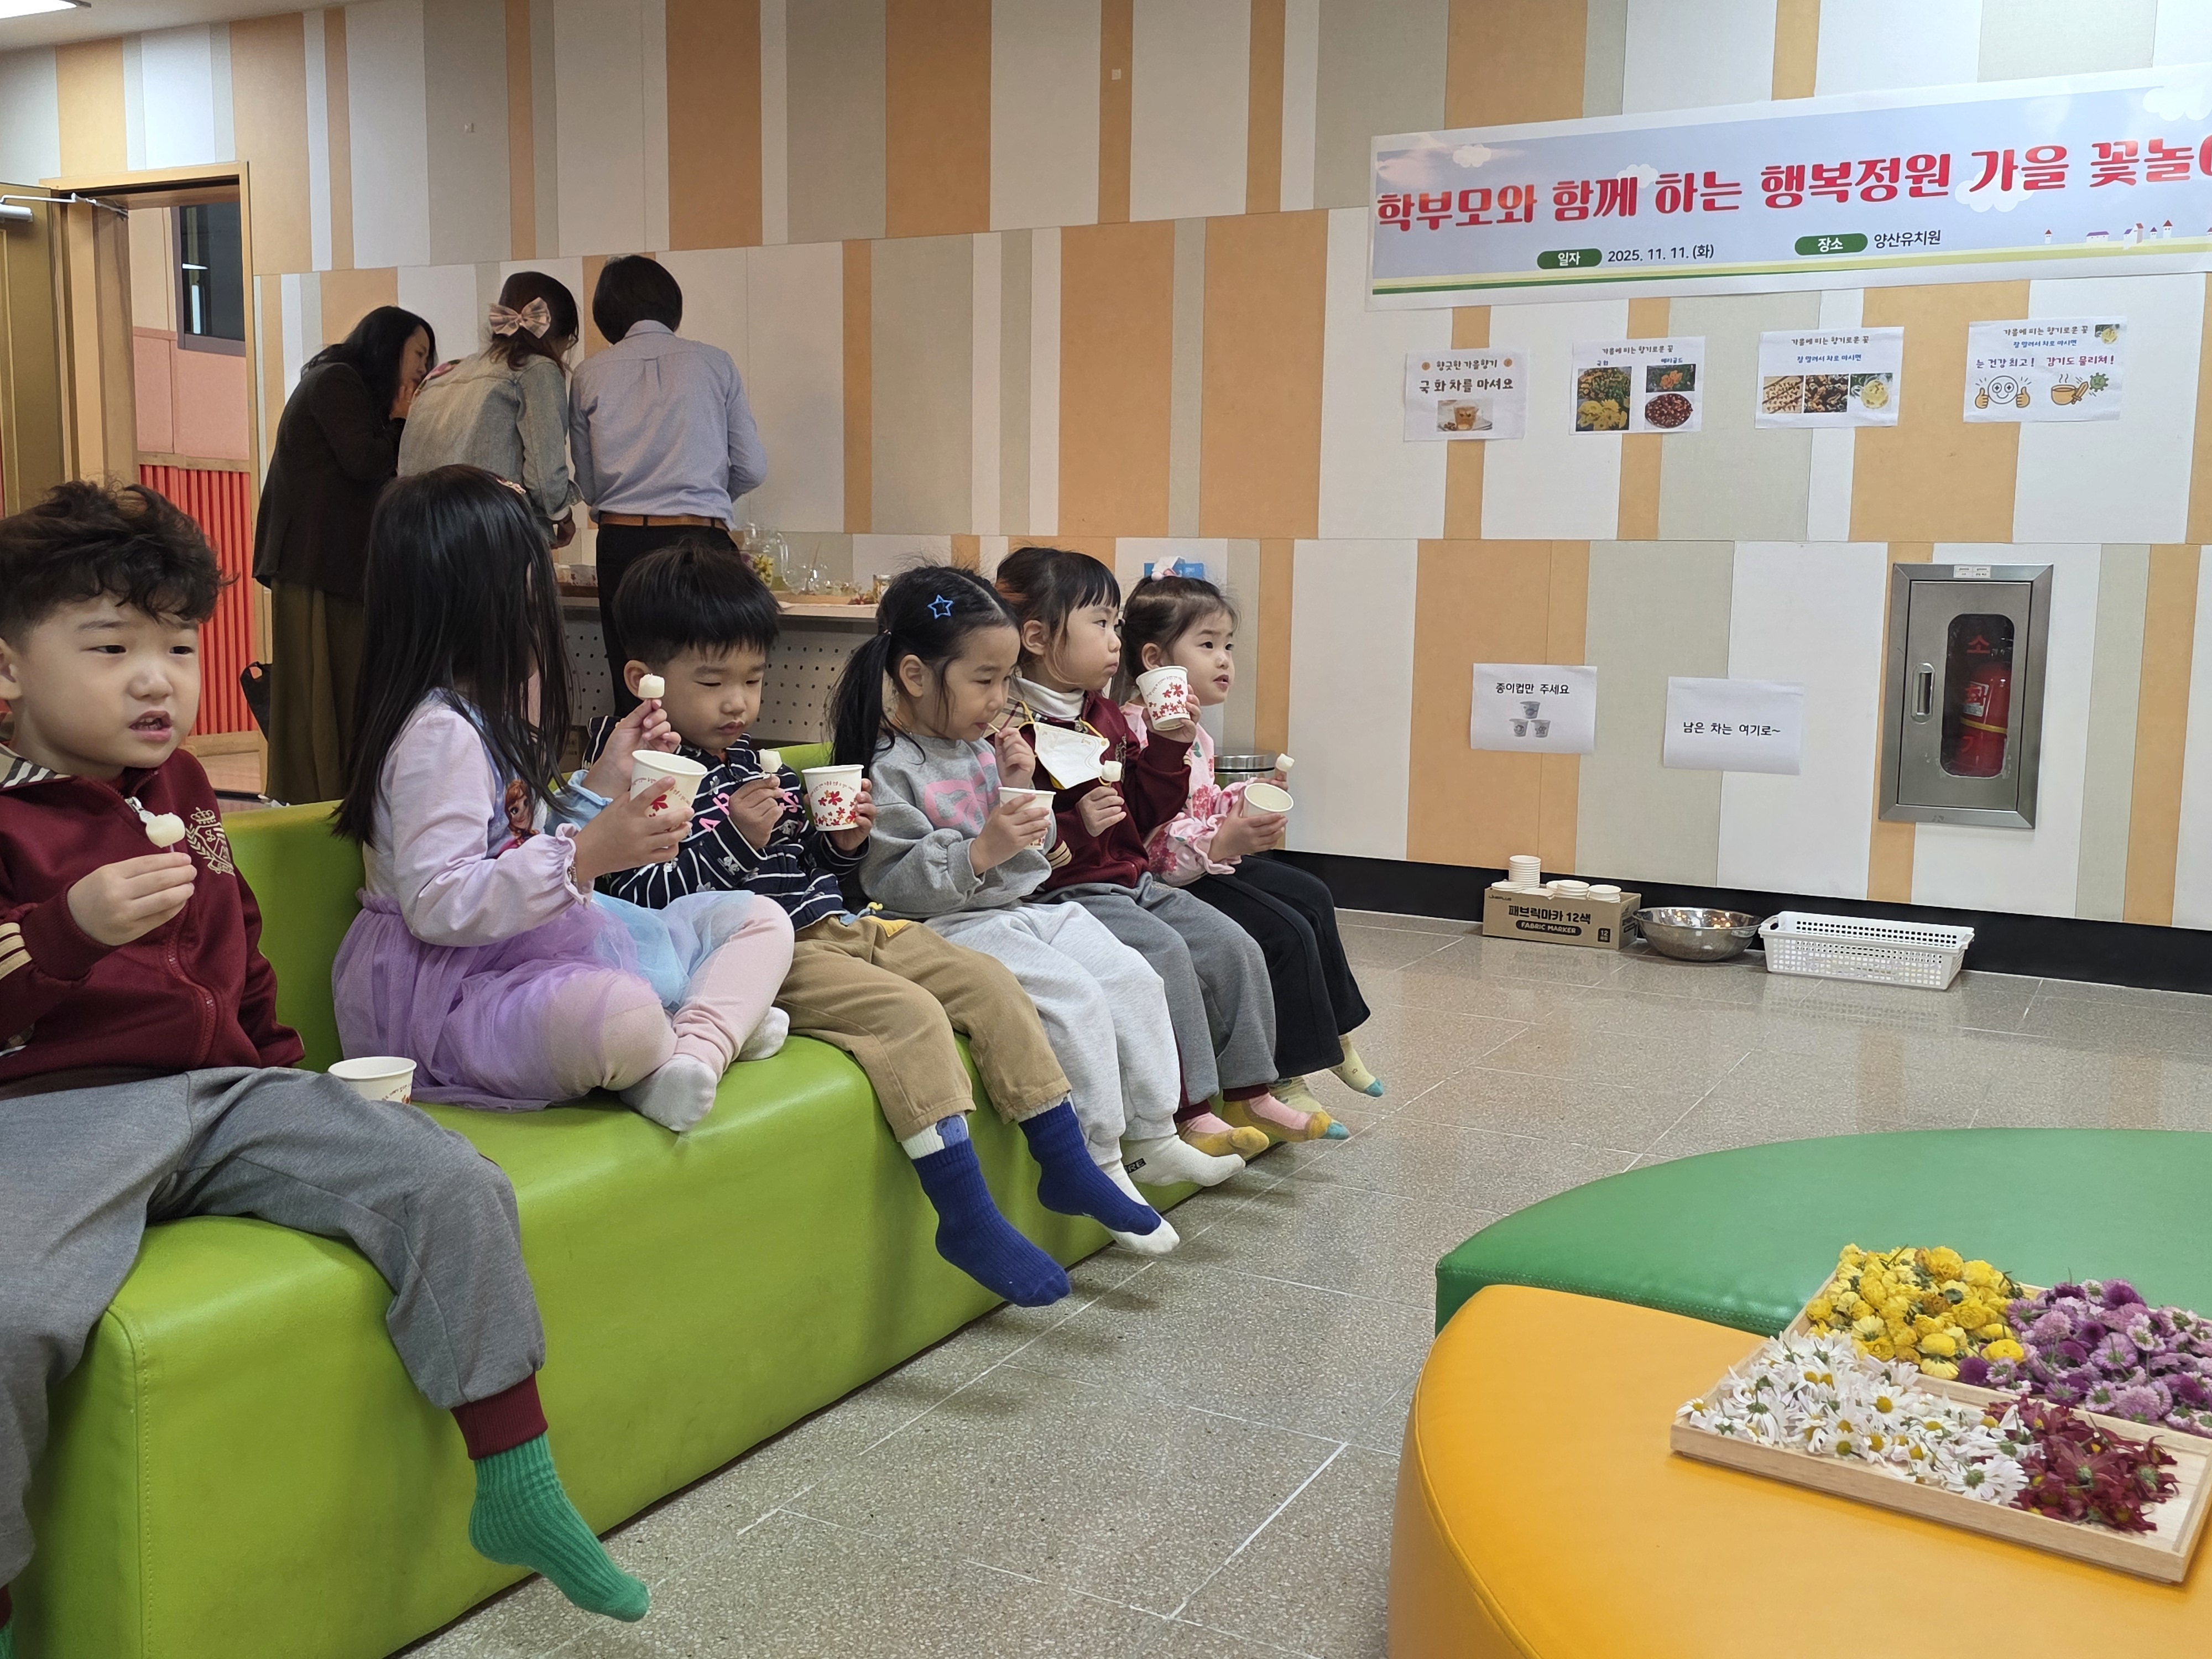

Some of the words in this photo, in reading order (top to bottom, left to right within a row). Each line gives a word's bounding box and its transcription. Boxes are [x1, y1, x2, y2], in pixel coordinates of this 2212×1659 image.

[1378, 185, 1537, 231] 학부모와
[1553, 177, 1637, 221] 함께
[1656, 171, 1742, 213] 하는
[1761, 154, 1950, 208] 행복정원
[1970, 146, 2069, 191] 가을
[2089, 135, 2212, 187] 꽃놀
[1817, 237, 1844, 253] 장소
[1874, 229, 1941, 249] 양산유치원
[1558, 251, 1580, 267] 일자
[1608, 249, 1643, 262] 2025.
[1436, 360, 1461, 372] 향긋한
[1987, 358, 2007, 368] 건강
[2046, 357, 2075, 367] 감기도
[1477, 378, 1514, 390] 마셔요
[1496, 682, 1535, 694] 종이컵만
[1540, 684, 1570, 695] 주세요
[1683, 722, 1705, 734] 남은
[1710, 722, 1733, 735] 차는
[1739, 724, 1781, 737] 여기로~
[1508, 905, 1563, 921] 패브릭마카
[1566, 912, 1591, 924] 12색
[1521, 922, 1546, 930] FABRIC
[1124, 1159, 1145, 1173] RE
